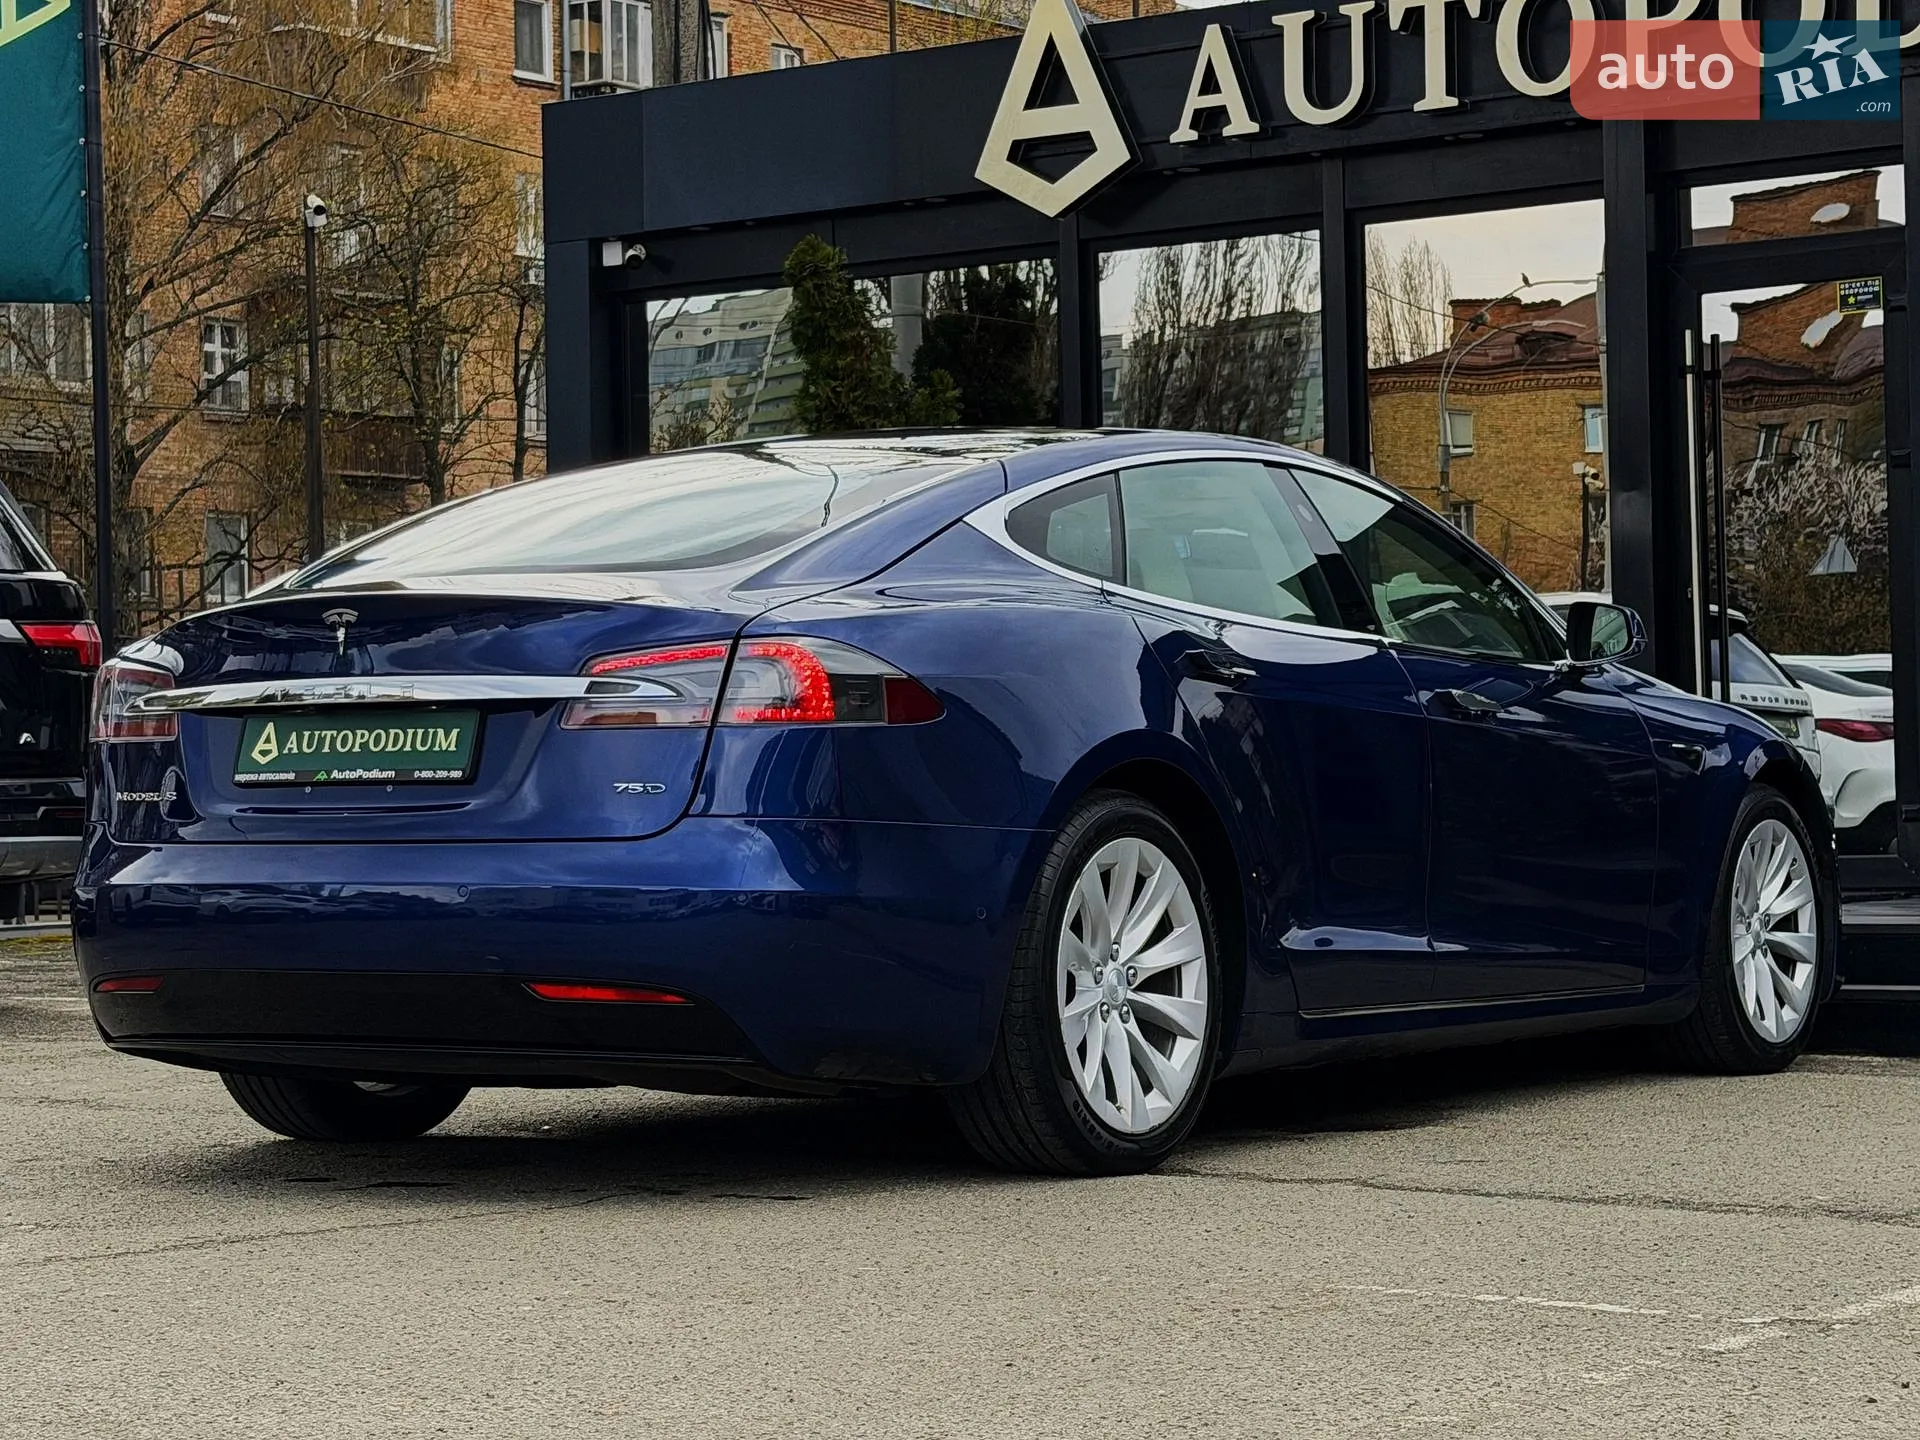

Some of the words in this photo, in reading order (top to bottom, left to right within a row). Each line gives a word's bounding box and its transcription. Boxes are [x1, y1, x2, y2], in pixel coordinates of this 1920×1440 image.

[282, 728, 460, 754] AUTOPODIUM
[331, 769, 395, 780] AutoPodium
[613, 783, 666, 793] 75D
